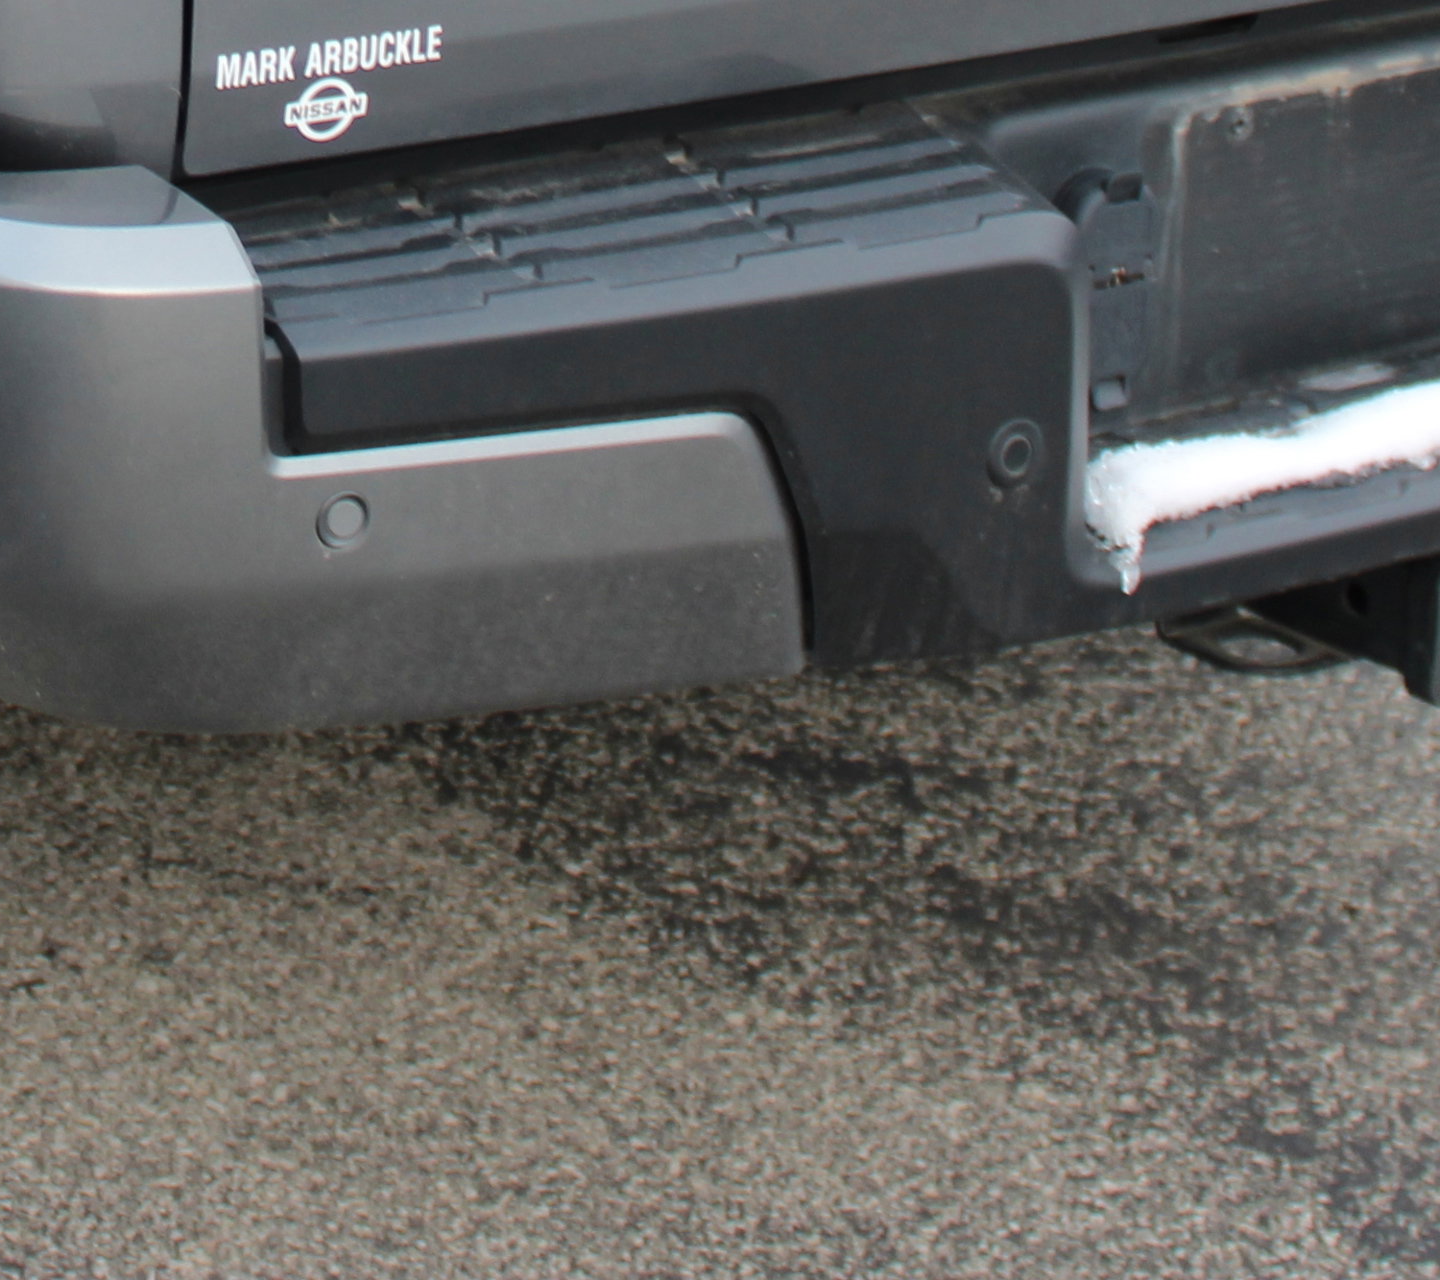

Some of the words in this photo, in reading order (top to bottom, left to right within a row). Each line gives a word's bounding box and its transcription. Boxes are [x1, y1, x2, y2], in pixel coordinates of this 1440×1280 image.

[215, 45, 297, 91] MARK
[304, 24, 444, 79] ARBUCKLE
[289, 96, 364, 122] NISSAN
